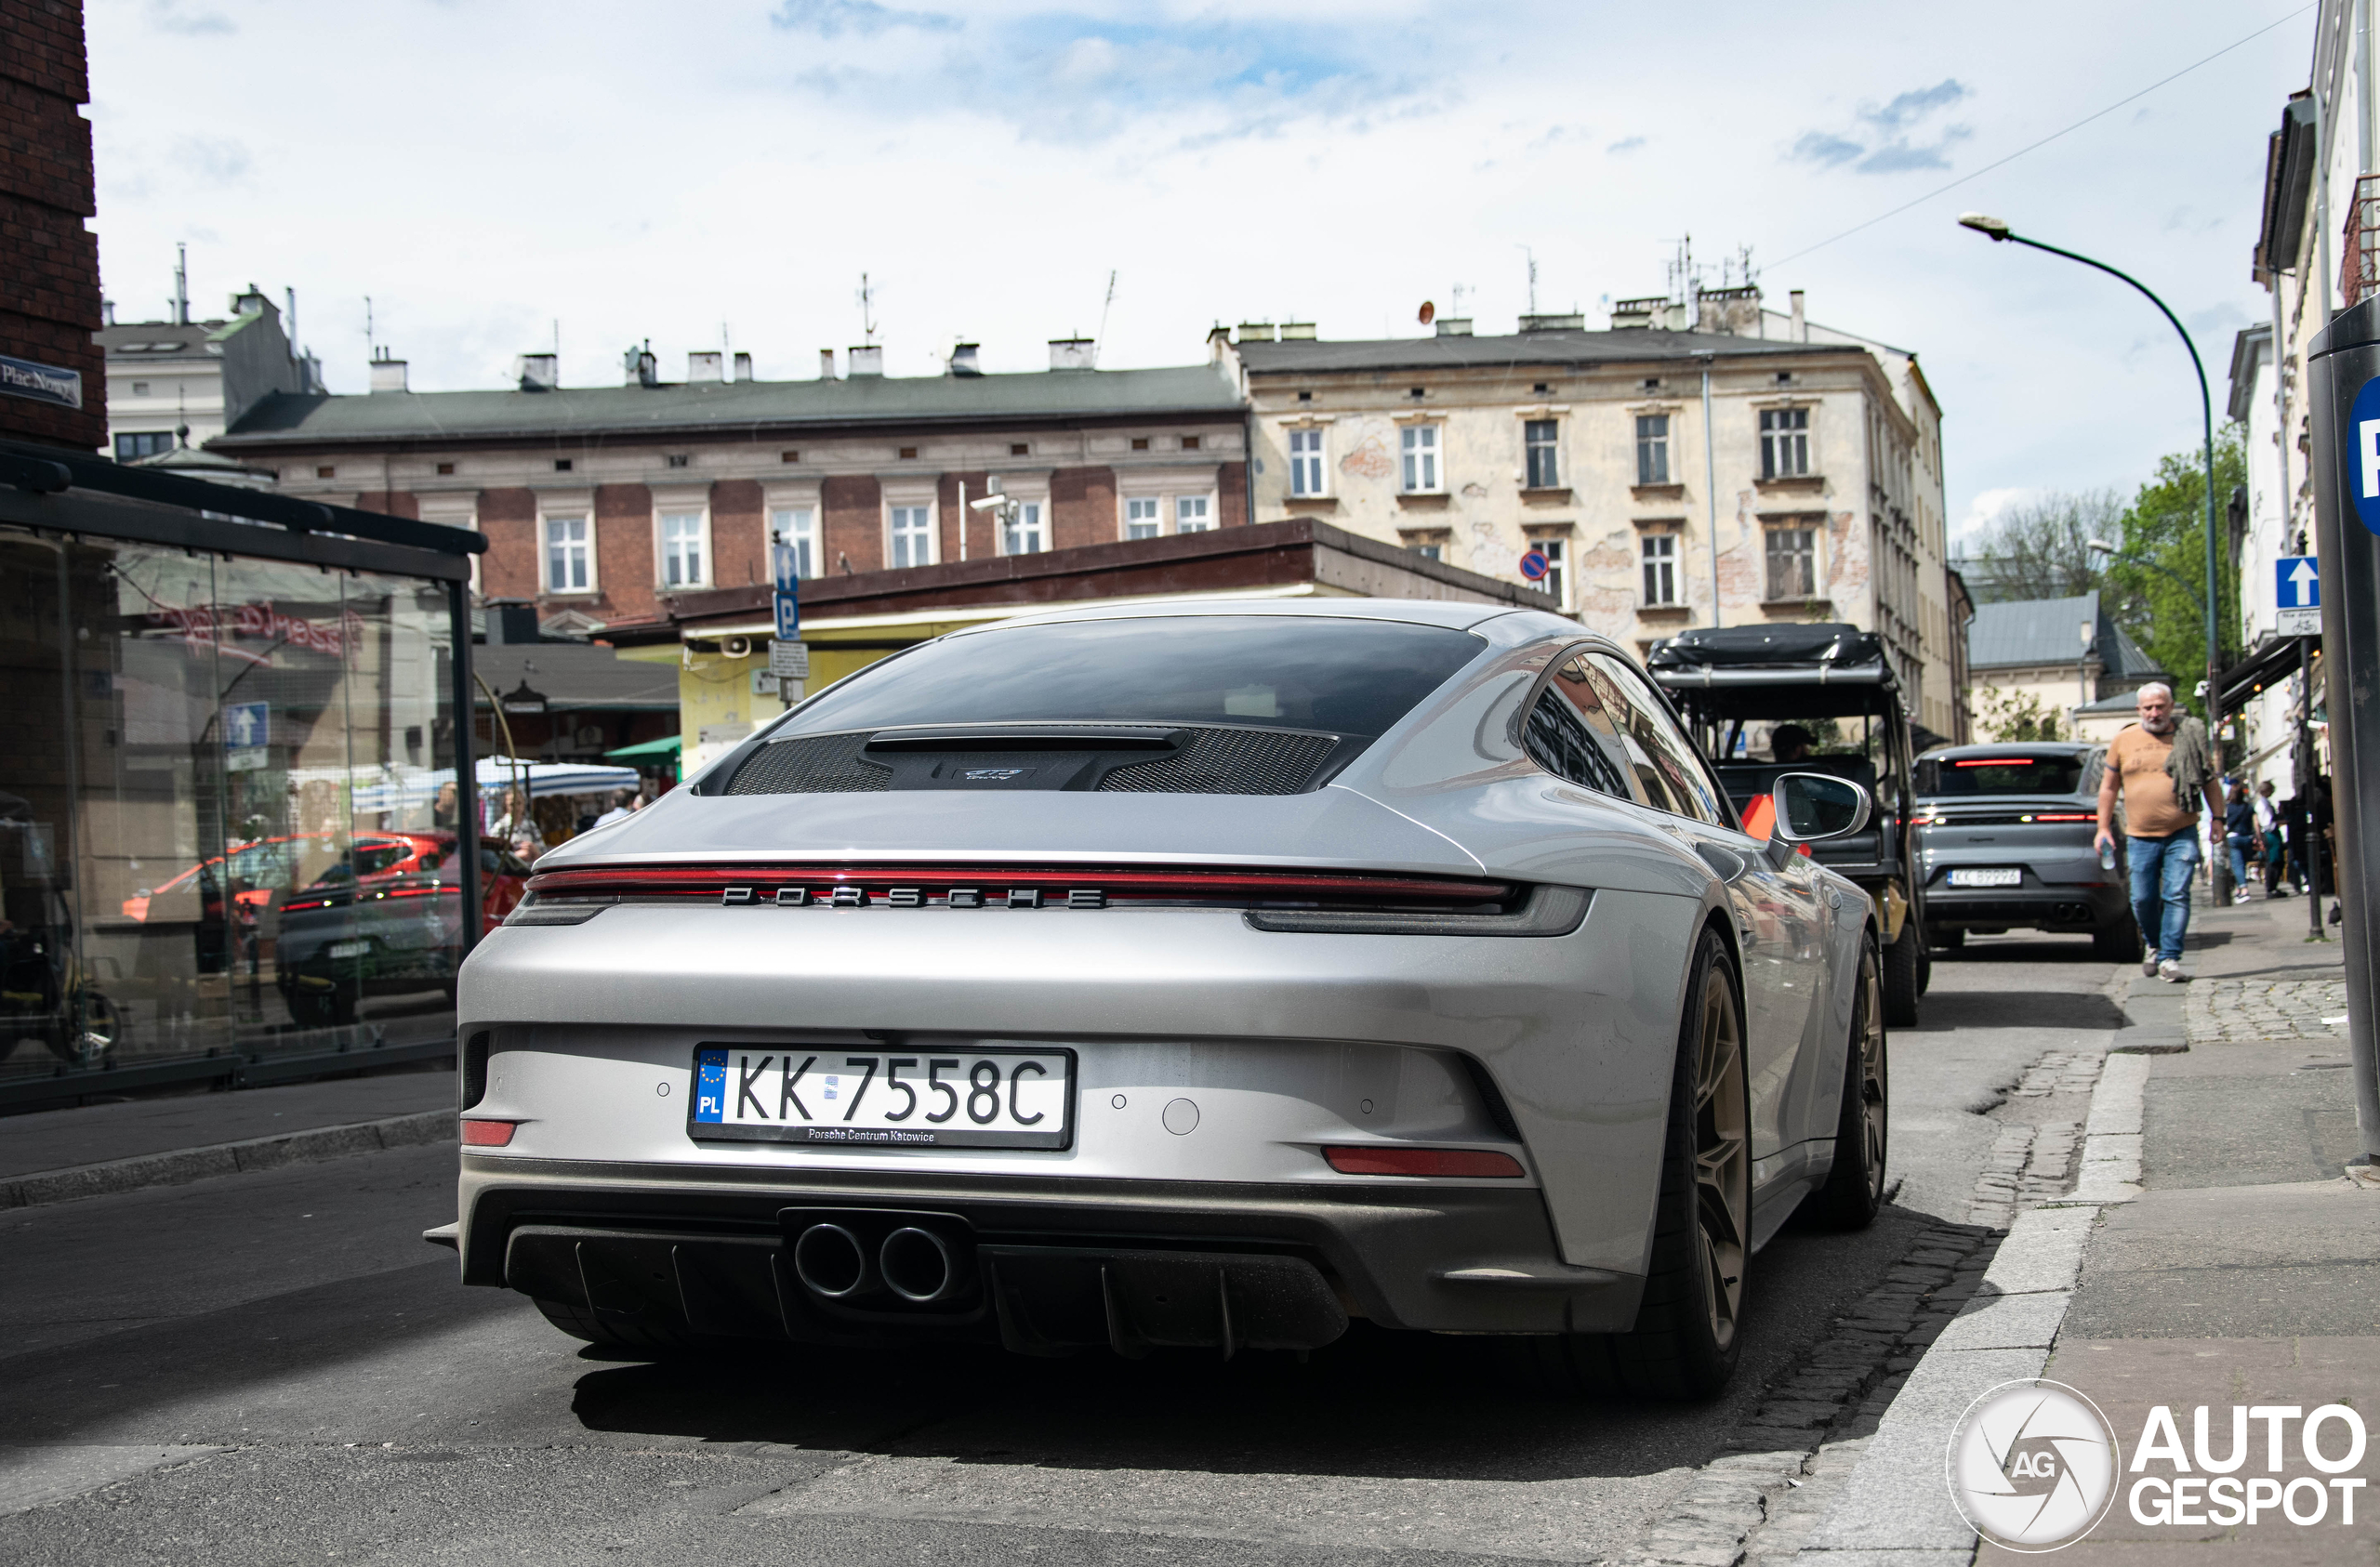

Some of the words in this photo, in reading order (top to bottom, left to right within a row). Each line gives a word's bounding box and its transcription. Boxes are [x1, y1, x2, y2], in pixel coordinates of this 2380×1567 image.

[2, 363, 31, 388] Plac
[780, 598, 795, 635] P
[722, 887, 1106, 909] PORSCHE
[737, 1055, 818, 1120] KK
[842, 1057, 1049, 1126] 7558C
[699, 1096, 721, 1113] PL
[808, 1127, 846, 1140] Porsche
[848, 1128, 889, 1141] Centrum
[891, 1130, 934, 1142] Katowice
